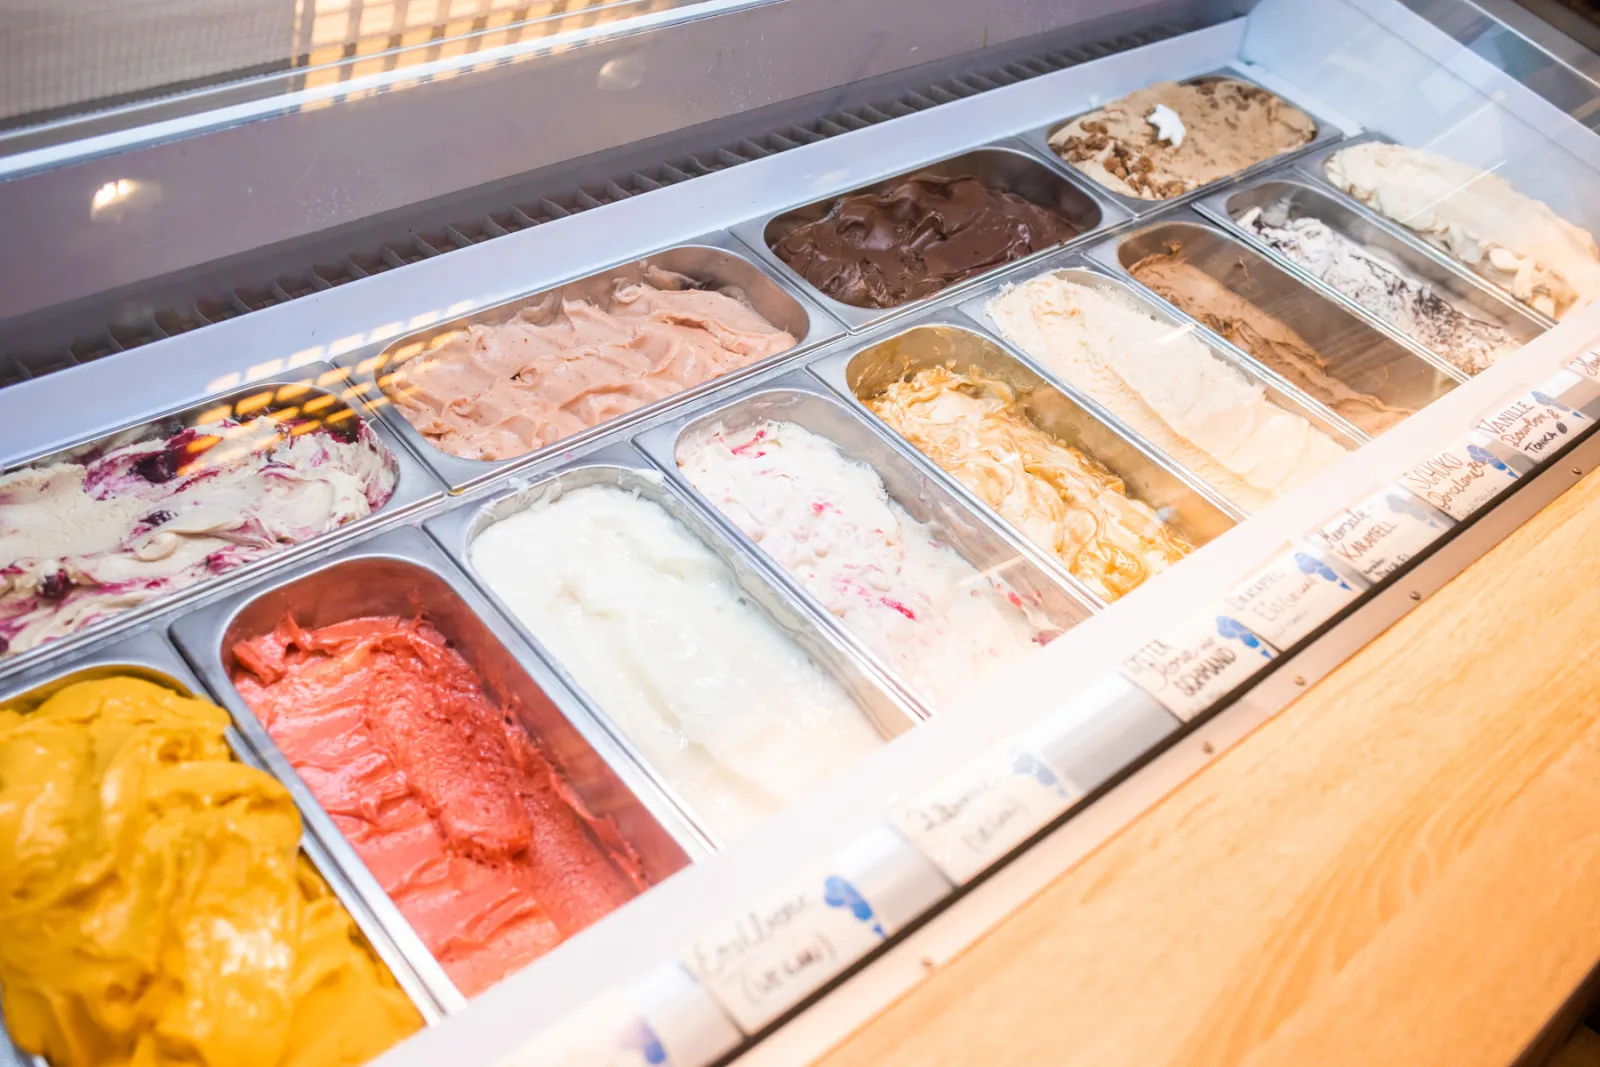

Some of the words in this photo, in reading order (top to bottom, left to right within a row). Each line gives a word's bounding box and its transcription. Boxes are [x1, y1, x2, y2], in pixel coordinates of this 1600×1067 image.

[1477, 401, 1536, 435] VANILLE
[1501, 412, 1550, 448] Bourbon
[1404, 453, 1464, 490] SCHOKO
[1337, 520, 1399, 563] KARAMELL
